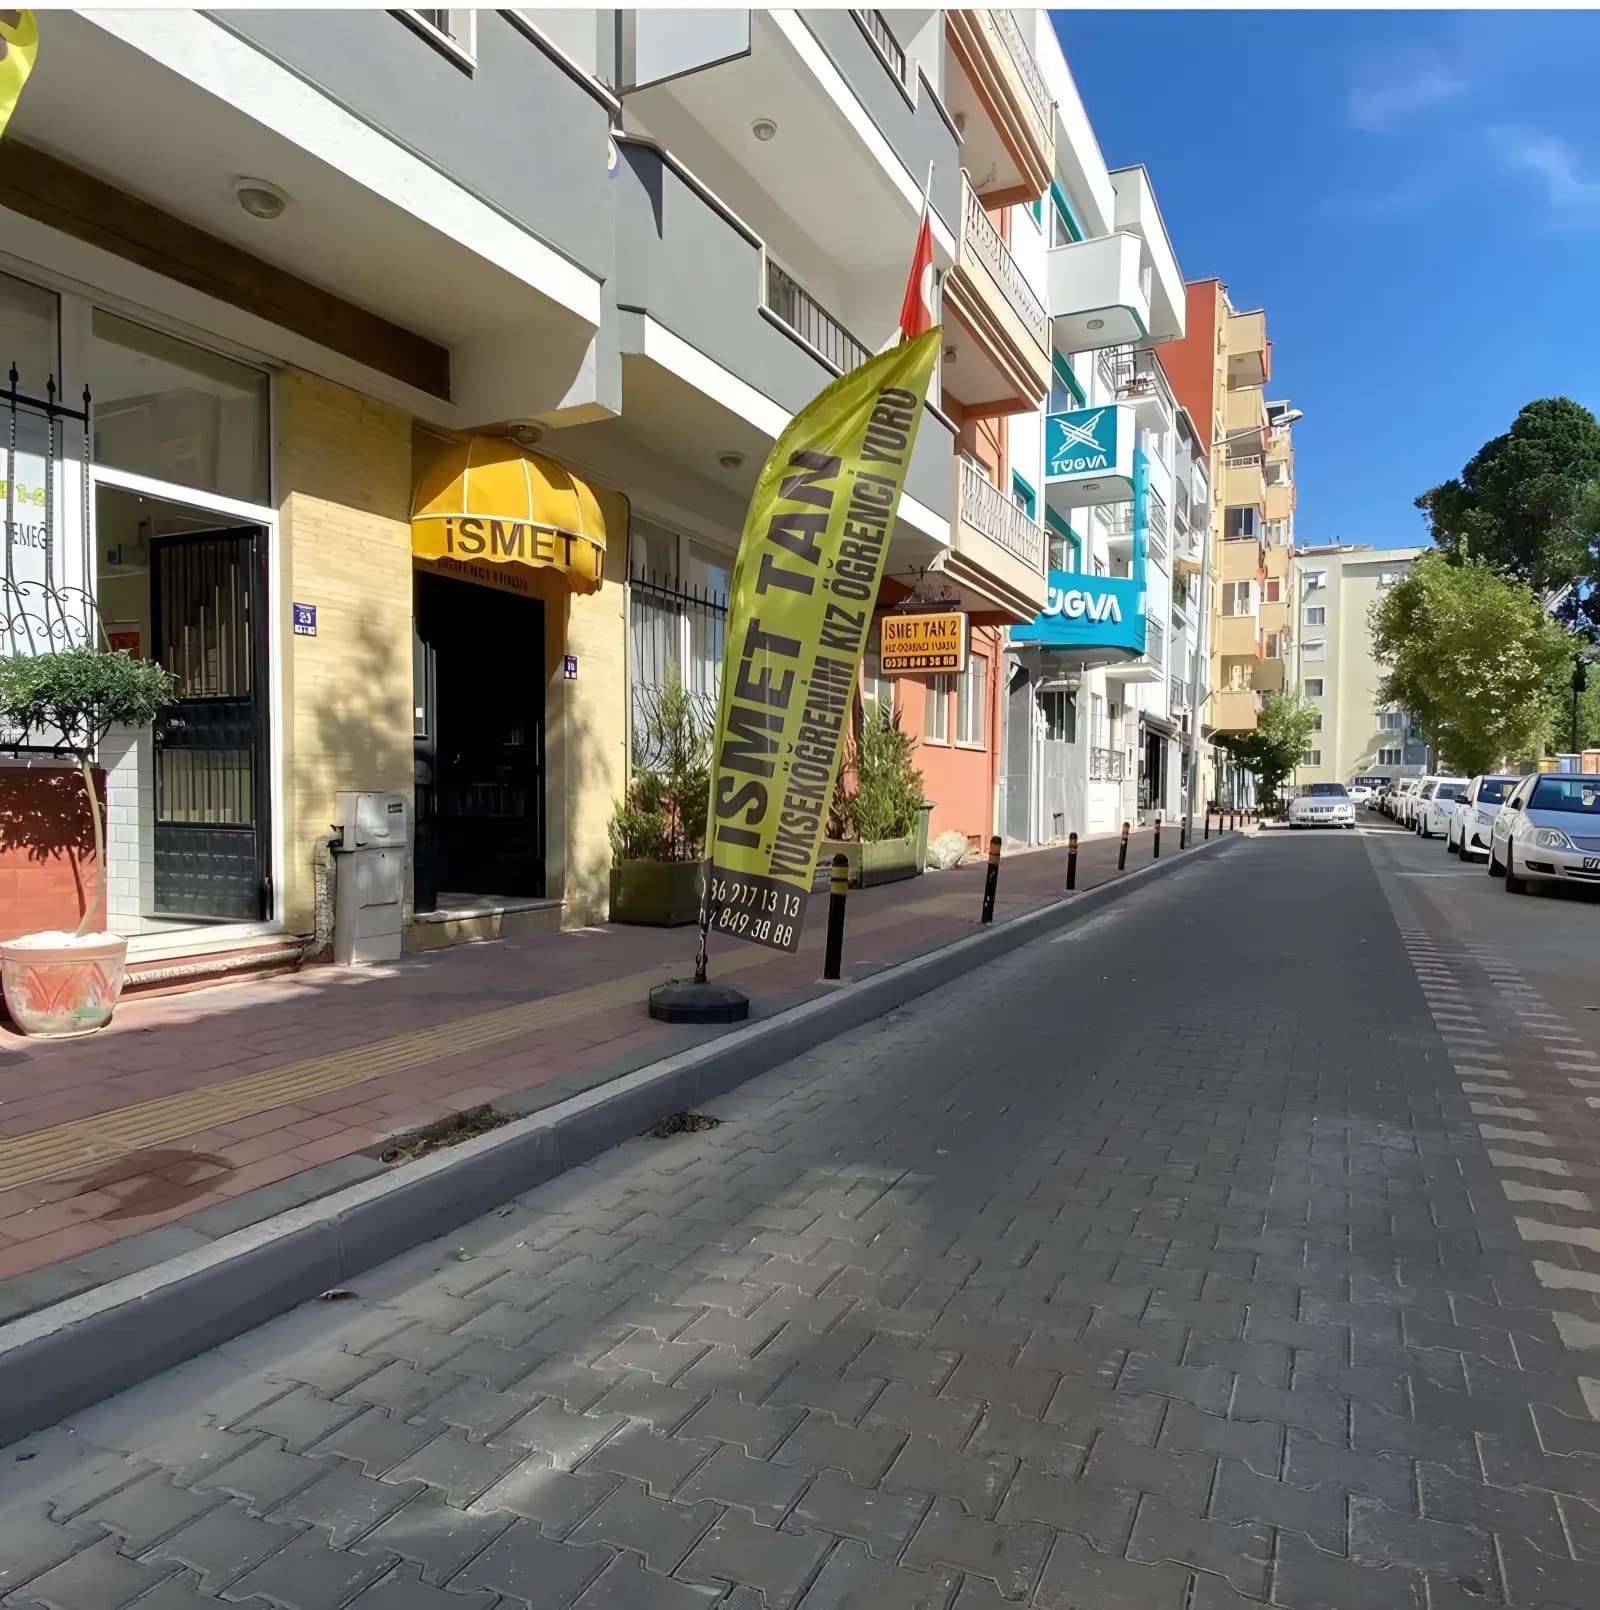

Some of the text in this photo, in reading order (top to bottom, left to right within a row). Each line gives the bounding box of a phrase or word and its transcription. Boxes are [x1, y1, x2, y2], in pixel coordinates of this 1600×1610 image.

[755, 450, 842, 596] TAN
[923, 620, 946, 638] TAN
[949, 620, 958, 636] 2
[765, 655, 854, 878] YÜKSEKÖĞRENİM
[819, 602, 866, 653] KIZ
[761, 889, 778, 912] 13
[783, 894, 800, 917] 13
[719, 907, 749, 934] 849
[751, 919, 771, 940] 38
[773, 924, 793, 946] 88
